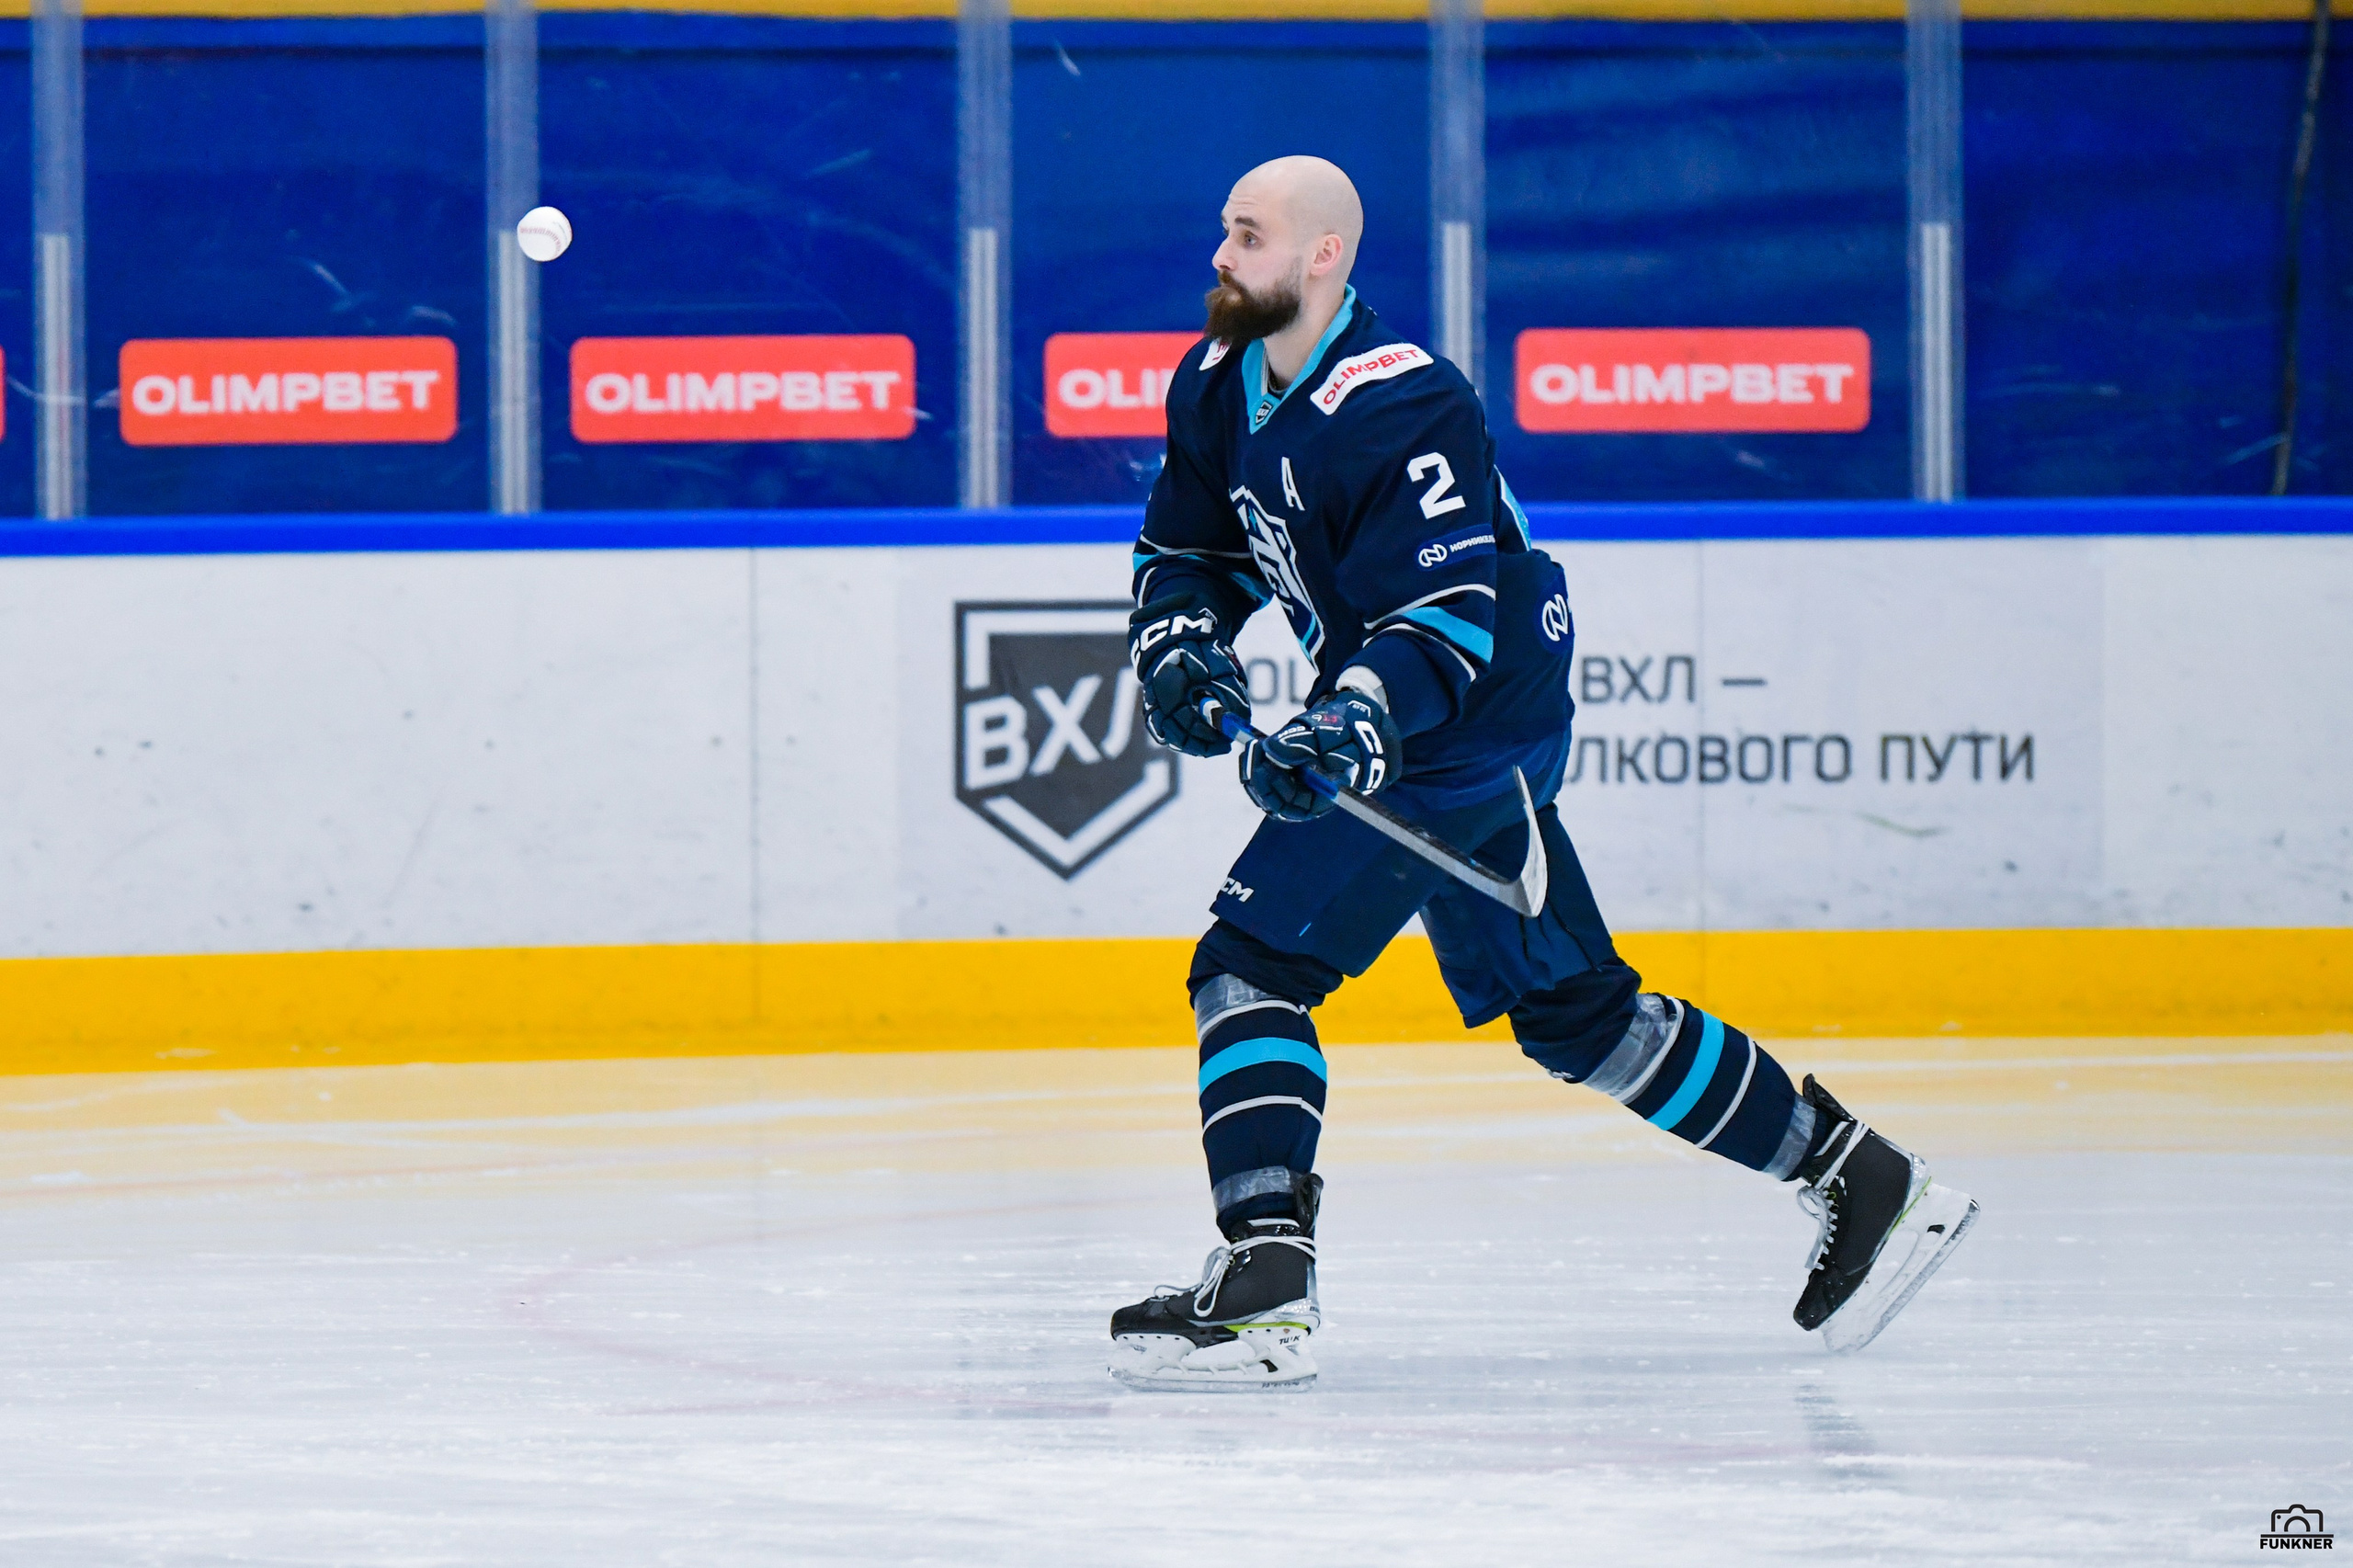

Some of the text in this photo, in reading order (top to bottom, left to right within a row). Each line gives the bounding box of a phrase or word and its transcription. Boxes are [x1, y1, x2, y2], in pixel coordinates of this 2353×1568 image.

[132, 370, 438, 415] OLIMPBET
[585, 371, 901, 414] OLIMPBET
[1324, 349, 1418, 405] OLIMPBET
[1531, 363, 1853, 403] OLIMPBET
[1281, 456, 1305, 511] A
[1407, 451, 1465, 518] 2
[1246, 656, 1305, 705] OL
[1580, 654, 1696, 704] ВХЛ
[1565, 733, 2034, 783] ЛКОВОГО ПУТИ
[1221, 877, 1254, 903] CM
